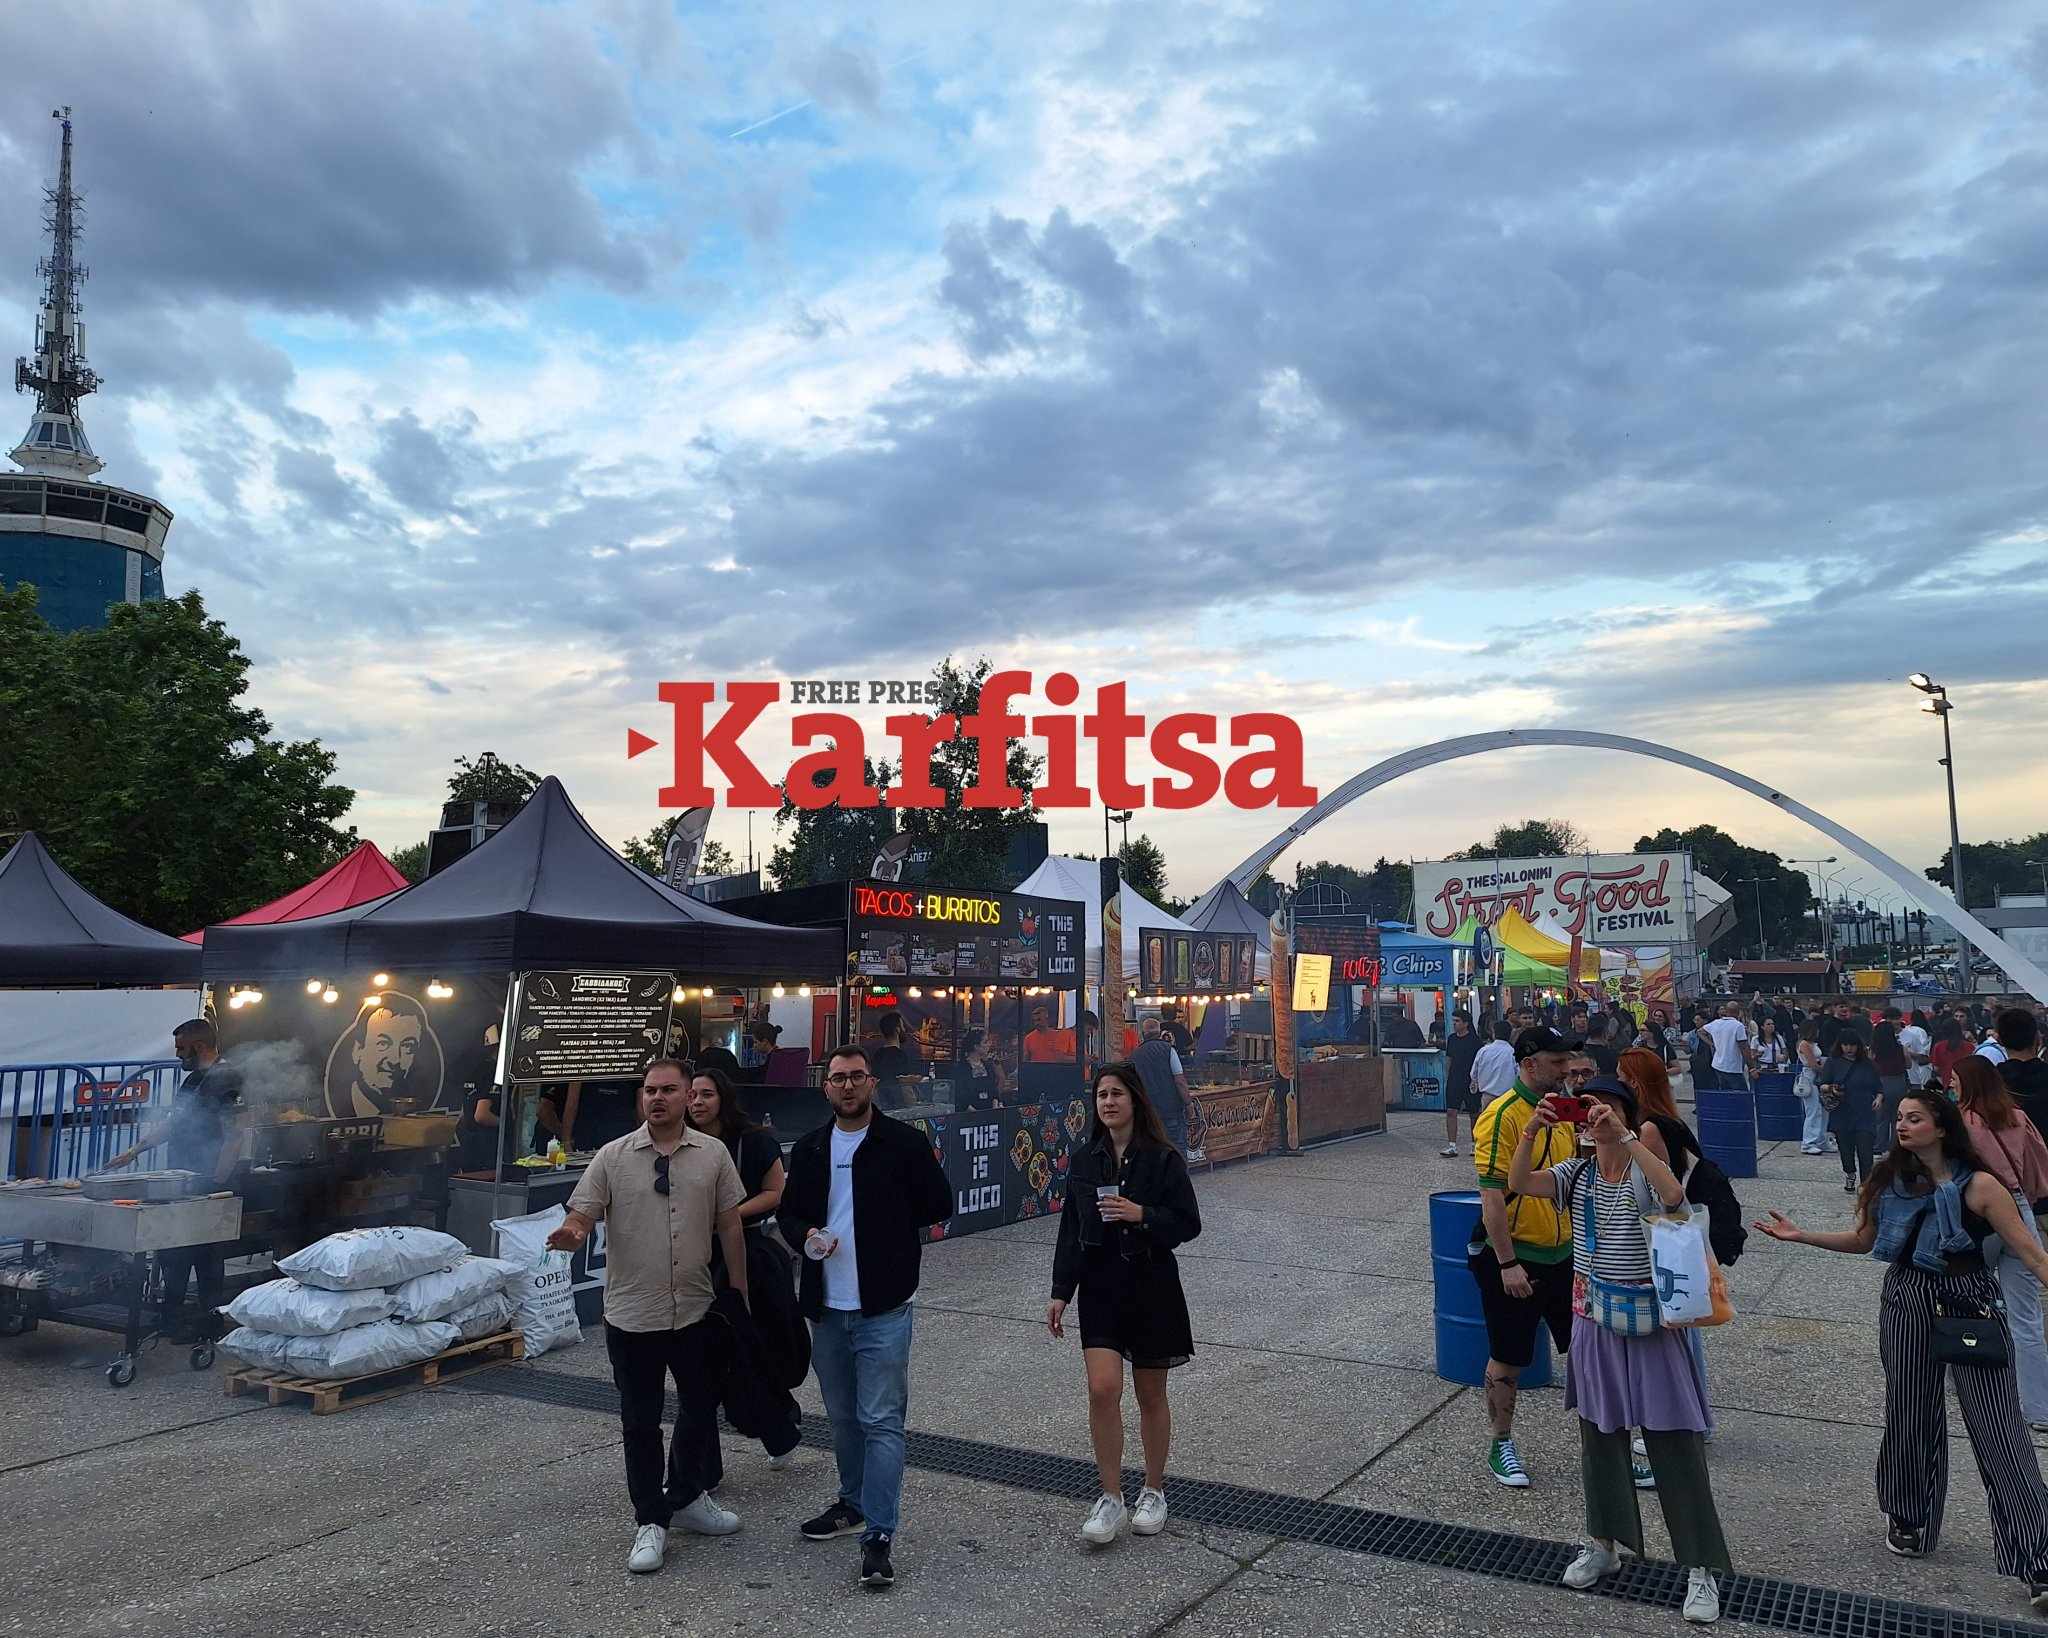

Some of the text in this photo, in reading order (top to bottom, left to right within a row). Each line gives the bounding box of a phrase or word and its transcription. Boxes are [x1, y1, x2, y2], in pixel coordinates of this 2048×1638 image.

[1466, 866, 1553, 890] THESSALONIKI
[855, 887, 913, 918] TACOS
[926, 894, 1001, 924] BURRITOS
[1550, 859, 1671, 936] Food
[1597, 910, 1674, 932] FESTIVAL
[1048, 957, 1076, 974] LOCO
[1392, 953, 1443, 978] Chips
[957, 1183, 1001, 1215] LOCO
